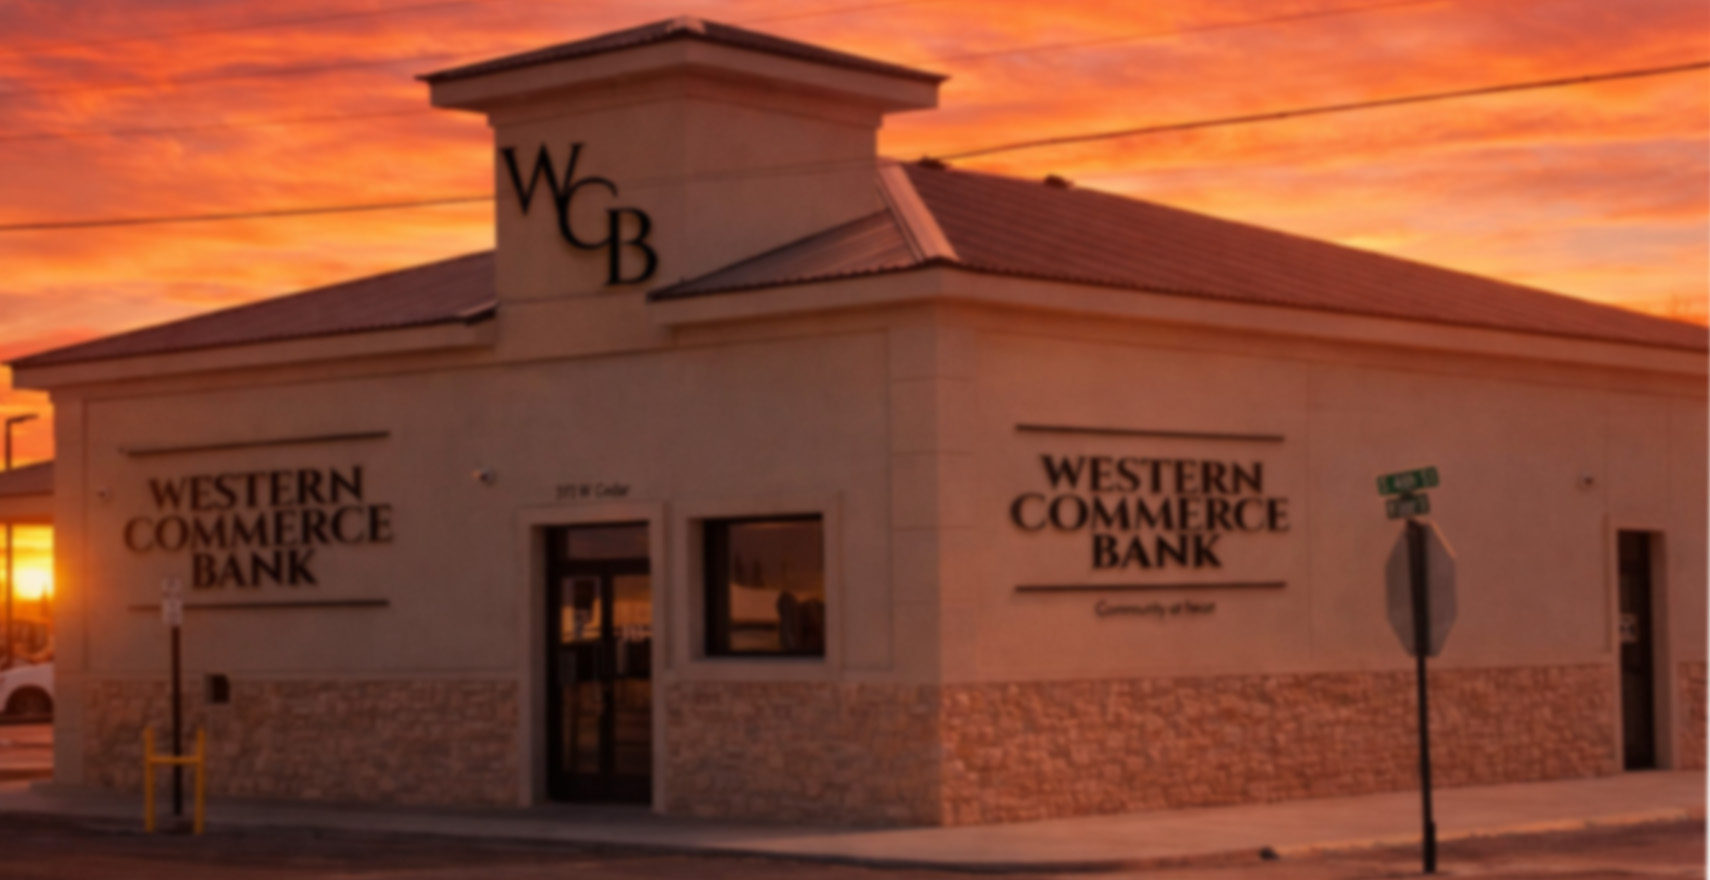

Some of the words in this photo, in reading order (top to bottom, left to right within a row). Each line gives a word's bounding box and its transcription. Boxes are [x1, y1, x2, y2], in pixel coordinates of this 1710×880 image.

[501, 142, 658, 285] WCB
[148, 466, 363, 511] WESTERN
[1040, 455, 1263, 494] WESTERN
[123, 504, 394, 552] COMMERCE
[1010, 493, 1290, 532] COMMERCE
[192, 548, 317, 589] BANK
[1092, 532, 1222, 568] BANK
